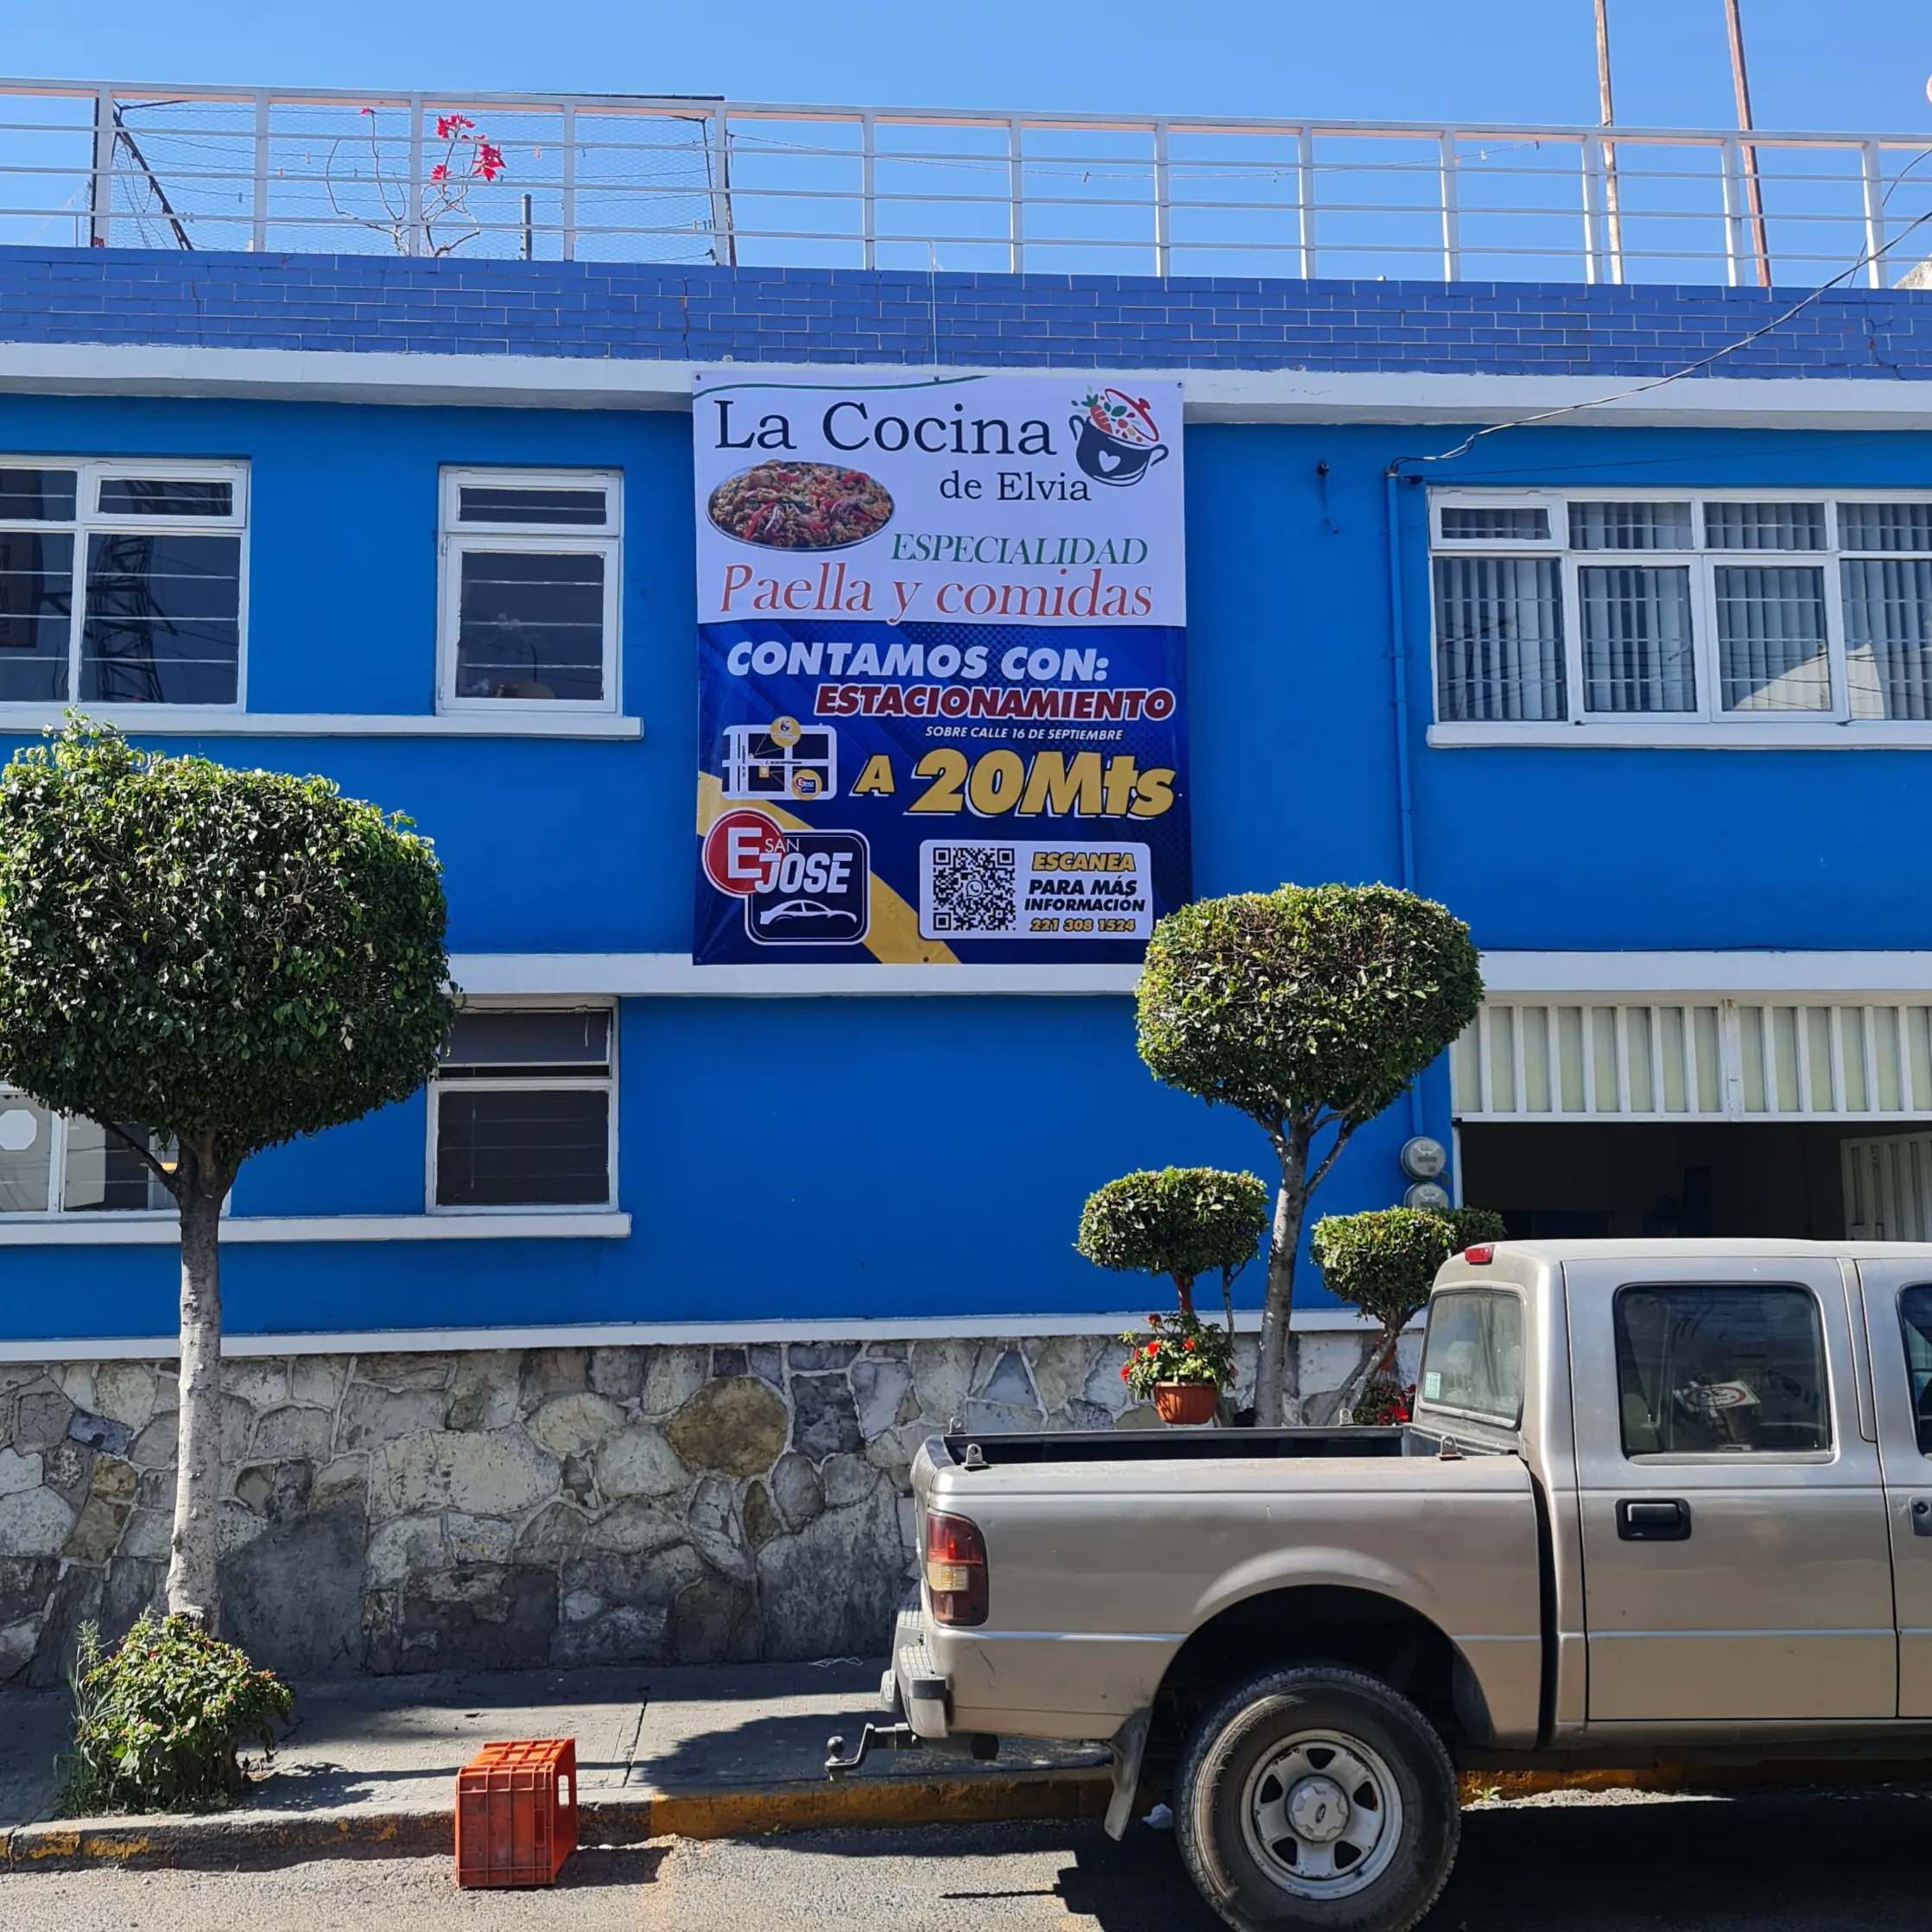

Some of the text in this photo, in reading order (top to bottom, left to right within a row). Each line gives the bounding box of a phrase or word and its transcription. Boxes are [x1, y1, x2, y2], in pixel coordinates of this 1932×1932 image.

[713, 400, 1058, 456] La Cocina
[940, 470, 1092, 502] de Elvia
[890, 533, 1148, 565] ESPECIALIDAD
[719, 562, 1153, 624] Paella y comidas
[726, 641, 1110, 682] CONTAMOS CON:
[814, 683, 1176, 721] ESTACIONAMIENTO
[925, 725, 1124, 740] SOBRE CALLE 16 DE SEPTIEMBRE
[850, 747, 1177, 819] A 20Mts
[727, 827, 763, 879] E
[763, 838, 800, 853] SAN
[754, 852, 853, 894] JOSE
[1031, 852, 1137, 872] ESCANEA
[1028, 875, 1137, 896] PARA MÁS
[1023, 895, 1146, 912] INFORMACIÓN
[1029, 918, 1137, 932] 221 308 1524
